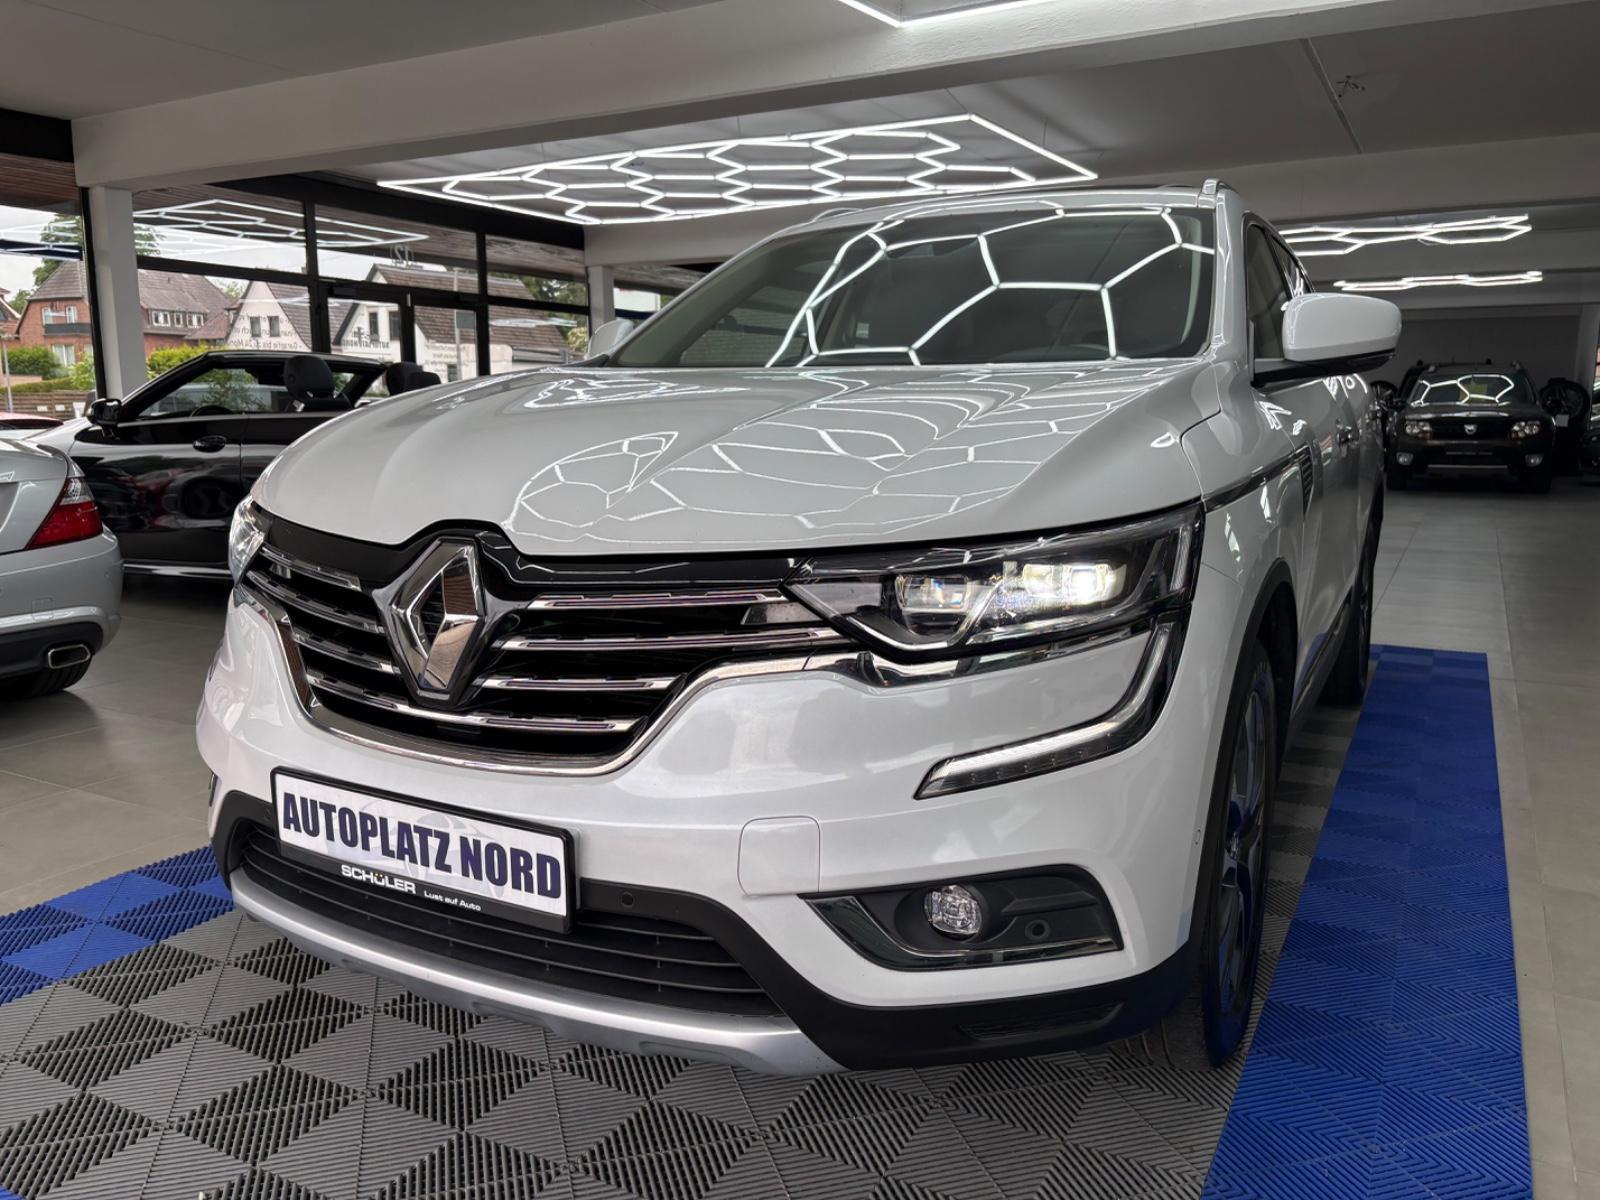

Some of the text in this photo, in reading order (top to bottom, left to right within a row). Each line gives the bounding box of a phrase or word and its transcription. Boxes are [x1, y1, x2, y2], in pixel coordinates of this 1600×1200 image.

[283, 792, 561, 899] AUTOPLATZ NORD
[341, 865, 416, 894] SCHÜLER
[424, 891, 443, 902] Lust
[460, 900, 481, 911] Auto
